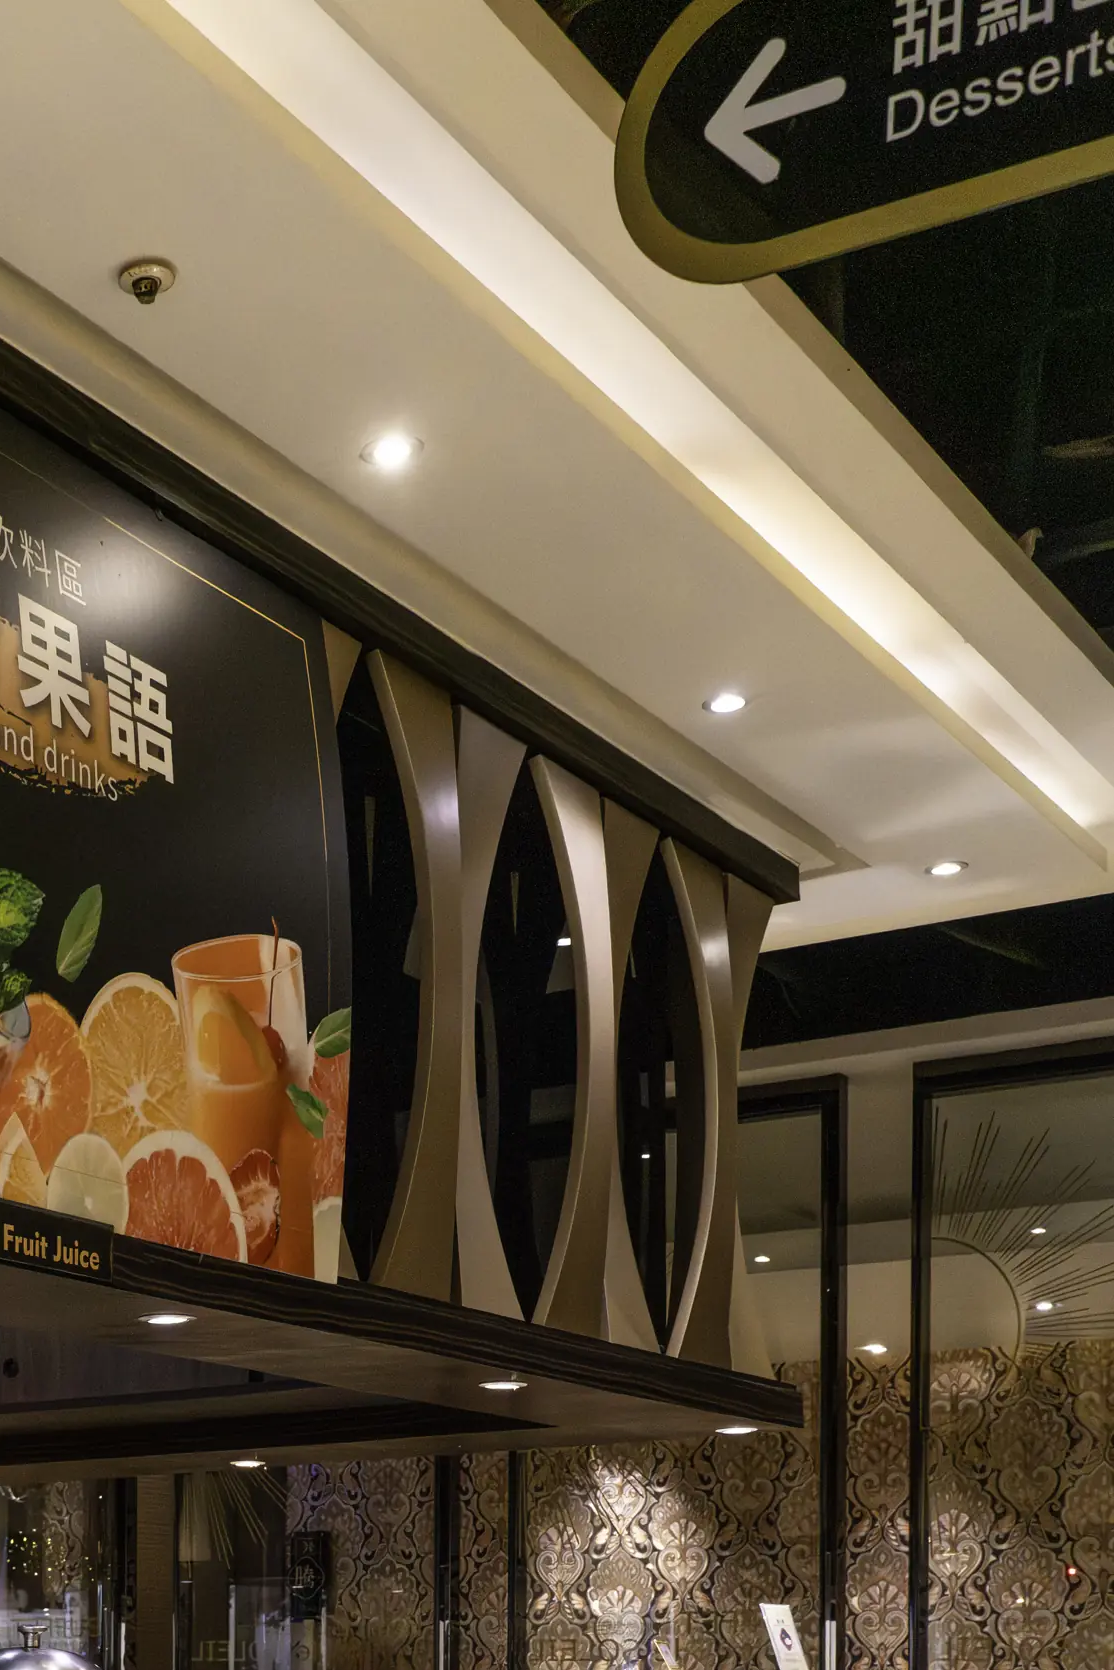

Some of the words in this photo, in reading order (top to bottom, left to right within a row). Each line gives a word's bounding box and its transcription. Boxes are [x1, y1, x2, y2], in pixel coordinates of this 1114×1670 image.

[44, 737, 118, 802] drinks
[3, 1223, 48, 1260] Fruit
[53, 1235, 100, 1271] Juice
